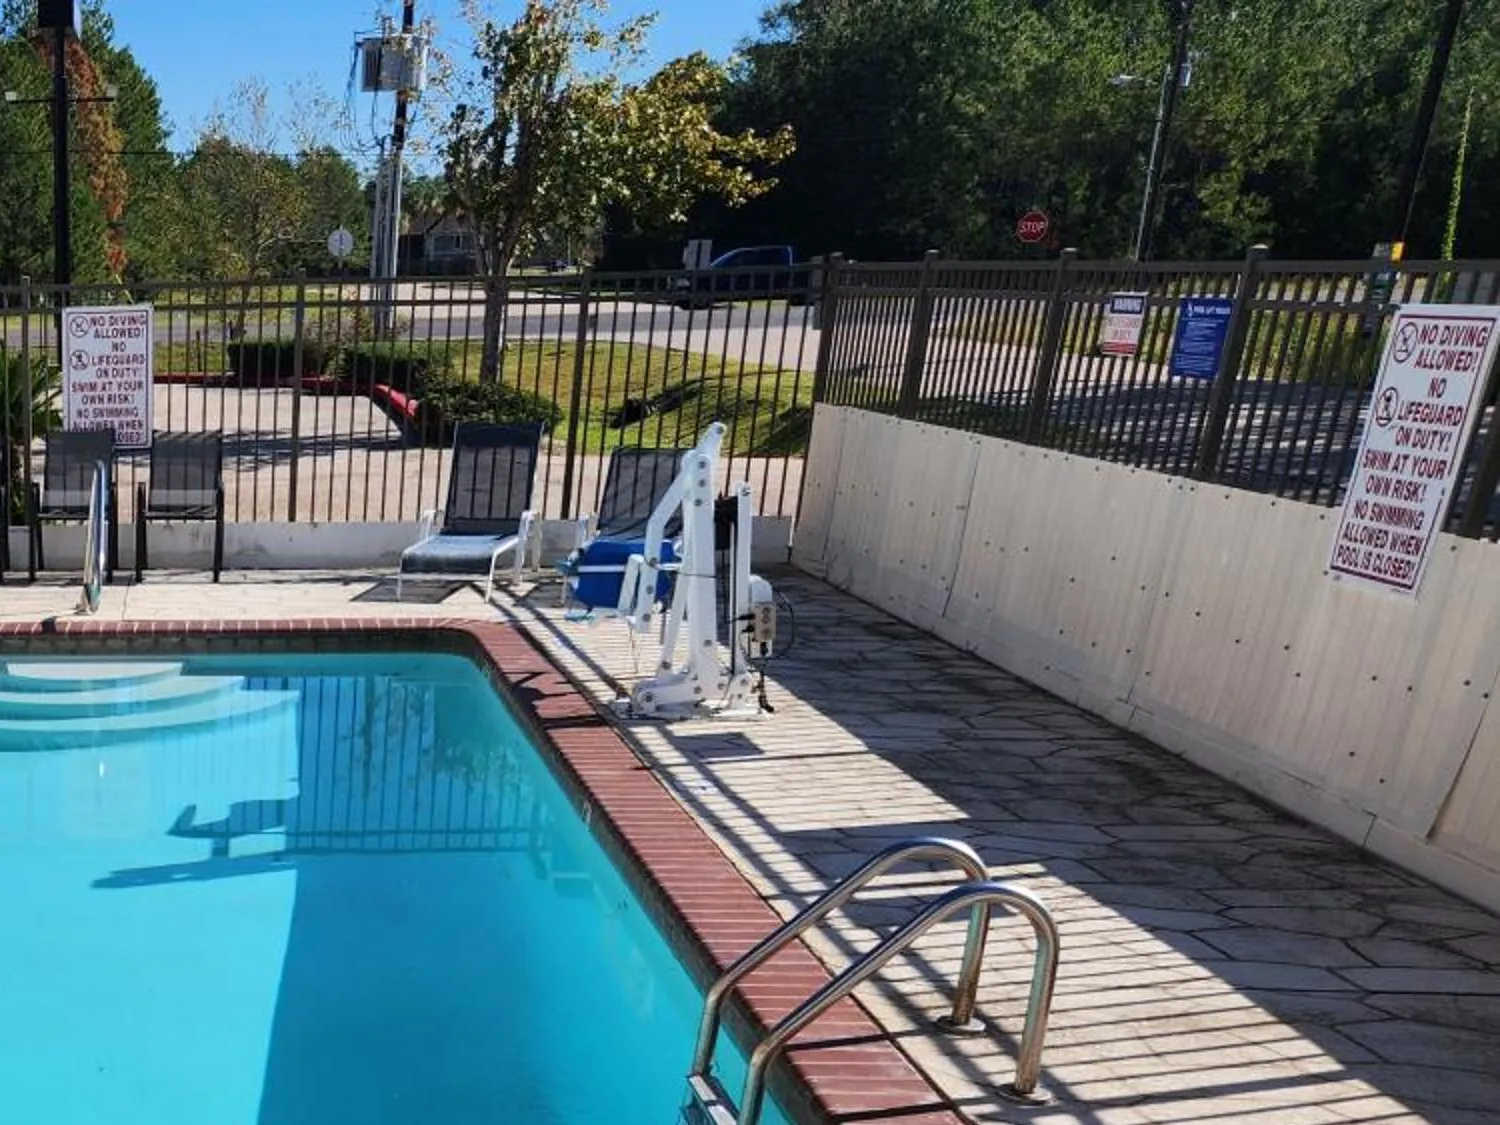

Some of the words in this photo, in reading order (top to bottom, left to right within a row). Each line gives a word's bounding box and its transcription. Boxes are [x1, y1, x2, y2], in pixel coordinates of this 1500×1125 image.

[1019, 221, 1045, 233] STOP
[90, 315, 105, 326] NO
[108, 314, 147, 326] DIVING
[93, 327, 145, 339] ALLOWED!
[1419, 324, 1438, 344] NO
[1439, 325, 1488, 348] DIVING
[111, 341, 127, 352] NO
[91, 353, 145, 366] LIFEGUARD
[1414, 348, 1478, 373] ALLOWED!
[95, 368, 109, 379] ON
[71, 381, 98, 393] SWIM
[100, 381, 113, 392] AT
[117, 380, 144, 391] YOUR
[1428, 378, 1447, 399] NO
[81, 394, 105, 405] OWN
[107, 394, 135, 405] RISK!
[76, 408, 90, 419] NO
[92, 408, 139, 418] SWIMMING
[1397, 399, 1464, 427] LIFEGUARD
[118, 419, 144, 431] WHEN
[1395, 427, 1413, 447] ON
[1414, 430, 1453, 453] DUTY!
[1362, 448, 1392, 472] SWIM
[1392, 453, 1409, 473] AT
[1411, 455, 1448, 479] YOUR
[1365, 475, 1392, 497] OWN
[1392, 479, 1427, 502] RISK!
[1353, 499, 1369, 518] NO
[1370, 503, 1425, 531] SWIMMING
[1342, 522, 1389, 549] ALLOWED
[1389, 531, 1424, 556] WHEN
[1335, 544, 1361, 569] POOL
[1360, 550, 1372, 570] IS
[1371, 553, 1415, 580] CLOSED!
